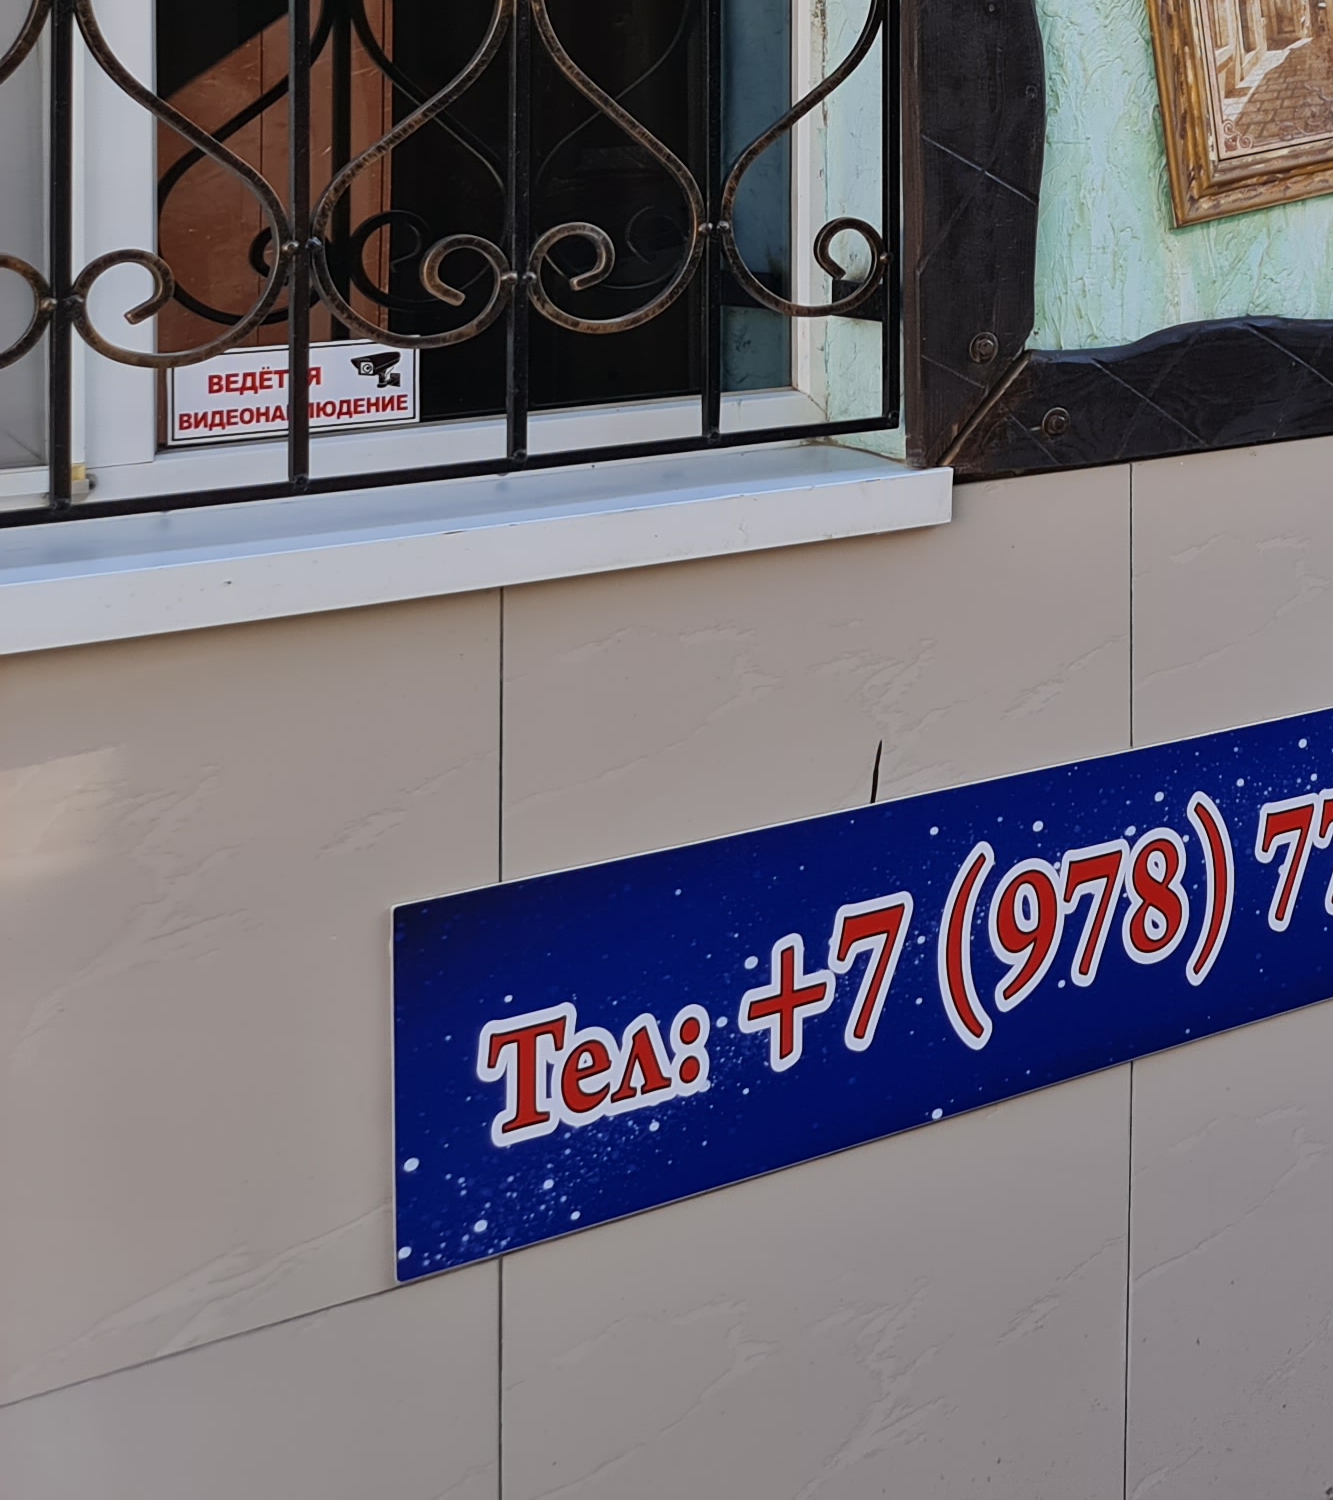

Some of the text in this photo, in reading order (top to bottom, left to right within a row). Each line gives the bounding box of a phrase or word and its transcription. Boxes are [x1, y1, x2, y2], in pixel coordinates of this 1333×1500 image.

[207, 366, 322, 396] ВЕДЁТЯ
[178, 394, 409, 431] ВИДЕОНАЮДЕНИЕ
[480, 1005, 706, 1142] Тел:
[741, 894, 909, 1069] +7
[940, 795, 1232, 1046] (978)
